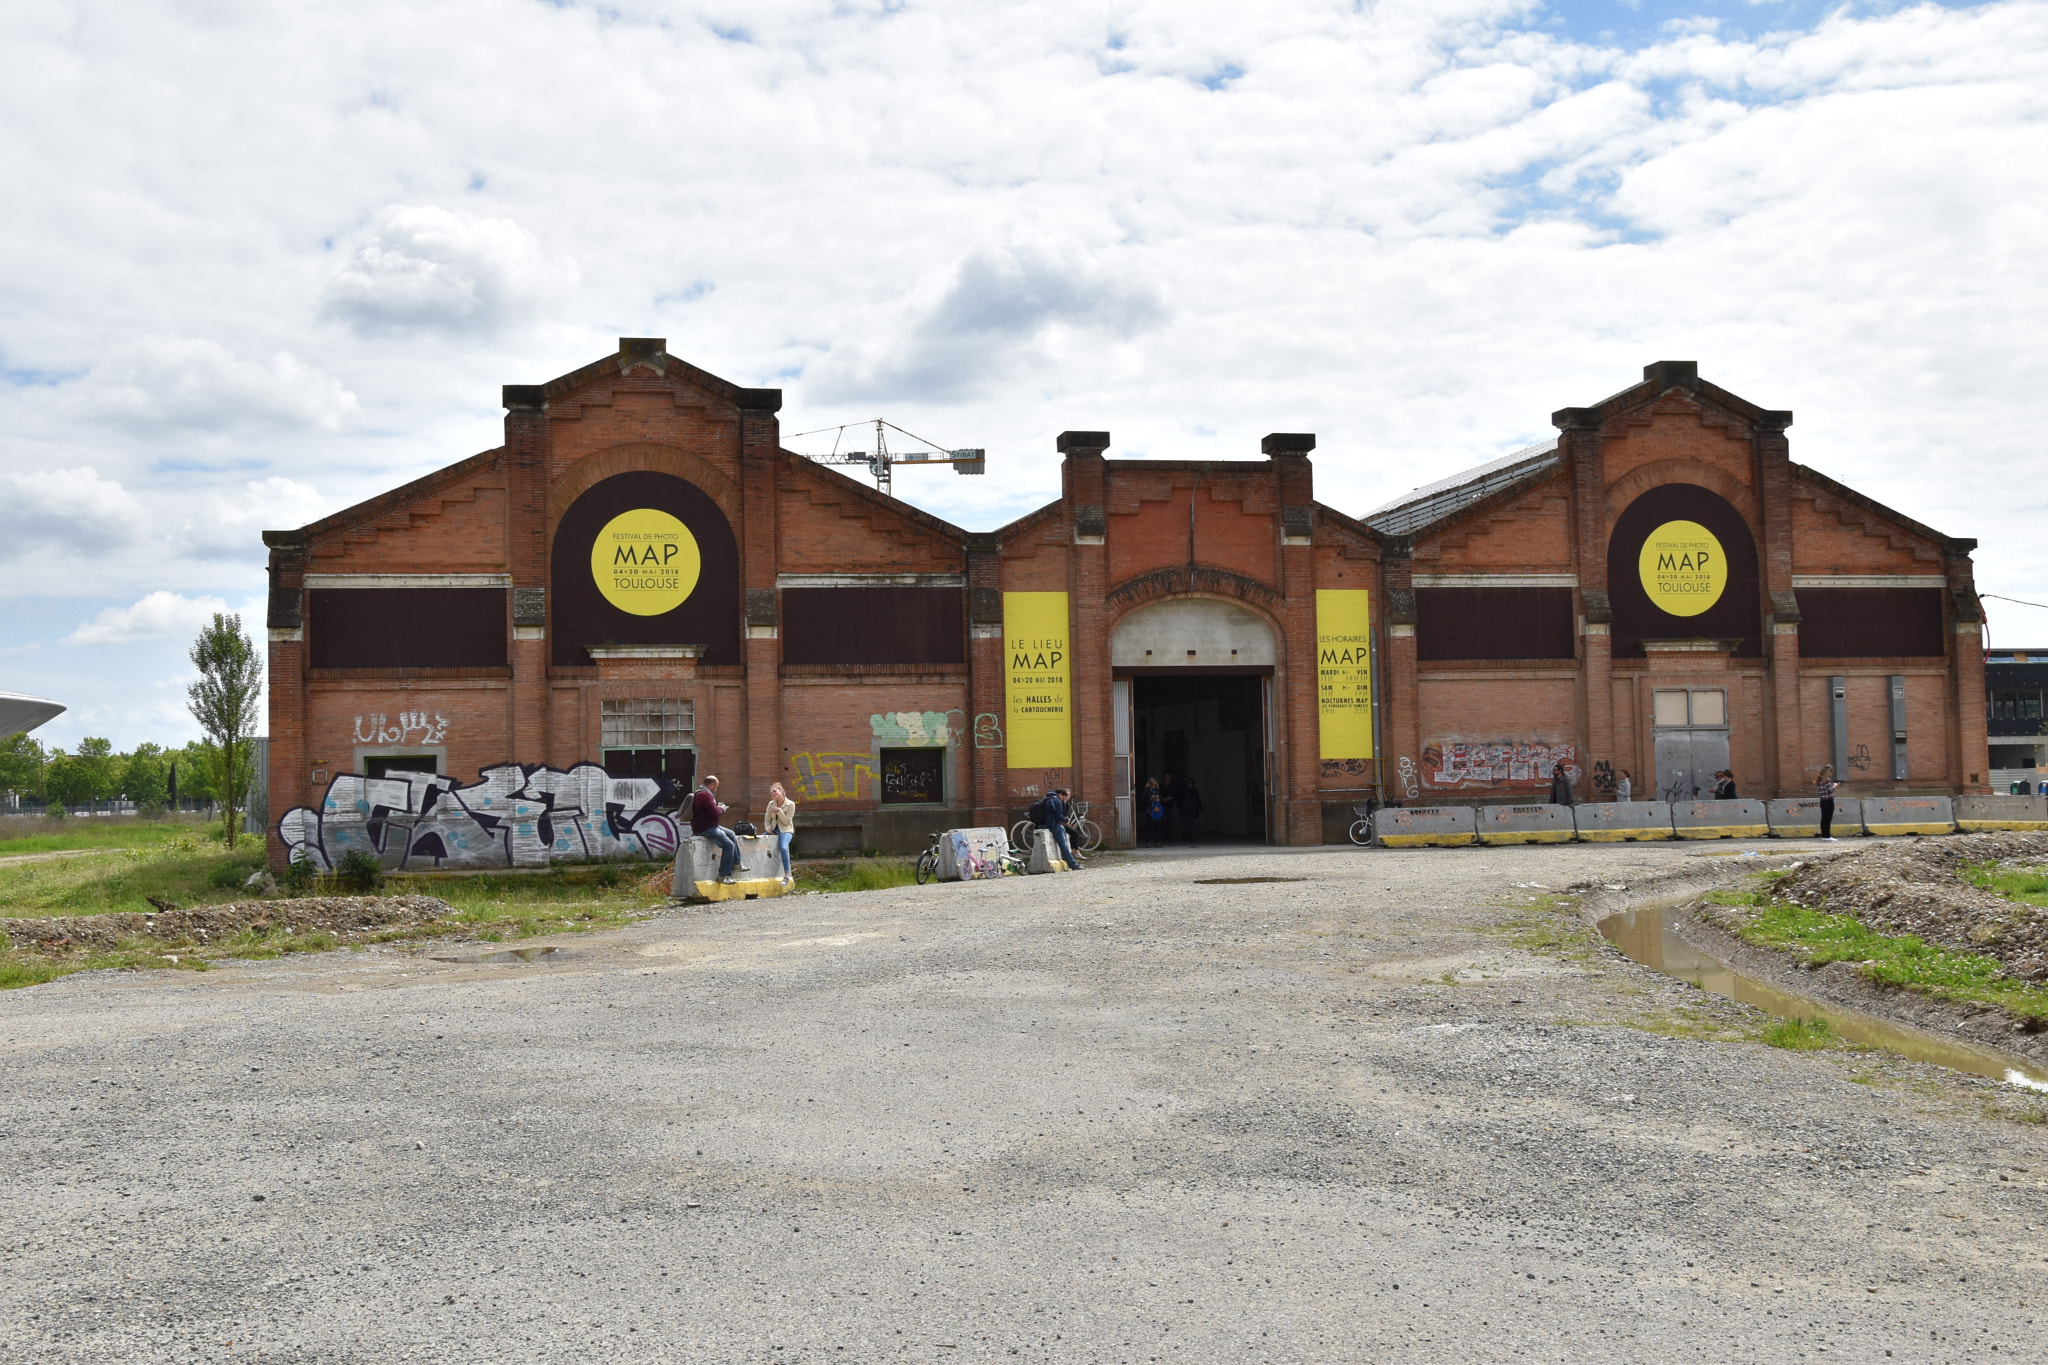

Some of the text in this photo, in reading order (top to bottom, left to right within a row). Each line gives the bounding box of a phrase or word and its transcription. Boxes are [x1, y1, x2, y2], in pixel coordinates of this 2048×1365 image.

[613, 543, 678, 565] MAP
[1657, 551, 1709, 571] MAP
[614, 578, 679, 589] TOULOUSE
[1658, 582, 1711, 593] TOULOUSE
[1011, 639, 1063, 649] LE LIEU
[1319, 635, 1367, 643] LES HORAIRES
[1012, 651, 1062, 669] MAP
[1320, 648, 1367, 664] MAP
[1012, 676, 1063, 684] 04>20 MAI 2018
[1013, 694, 1063, 704] les HALLES de
[1013, 705, 1019, 714] la
